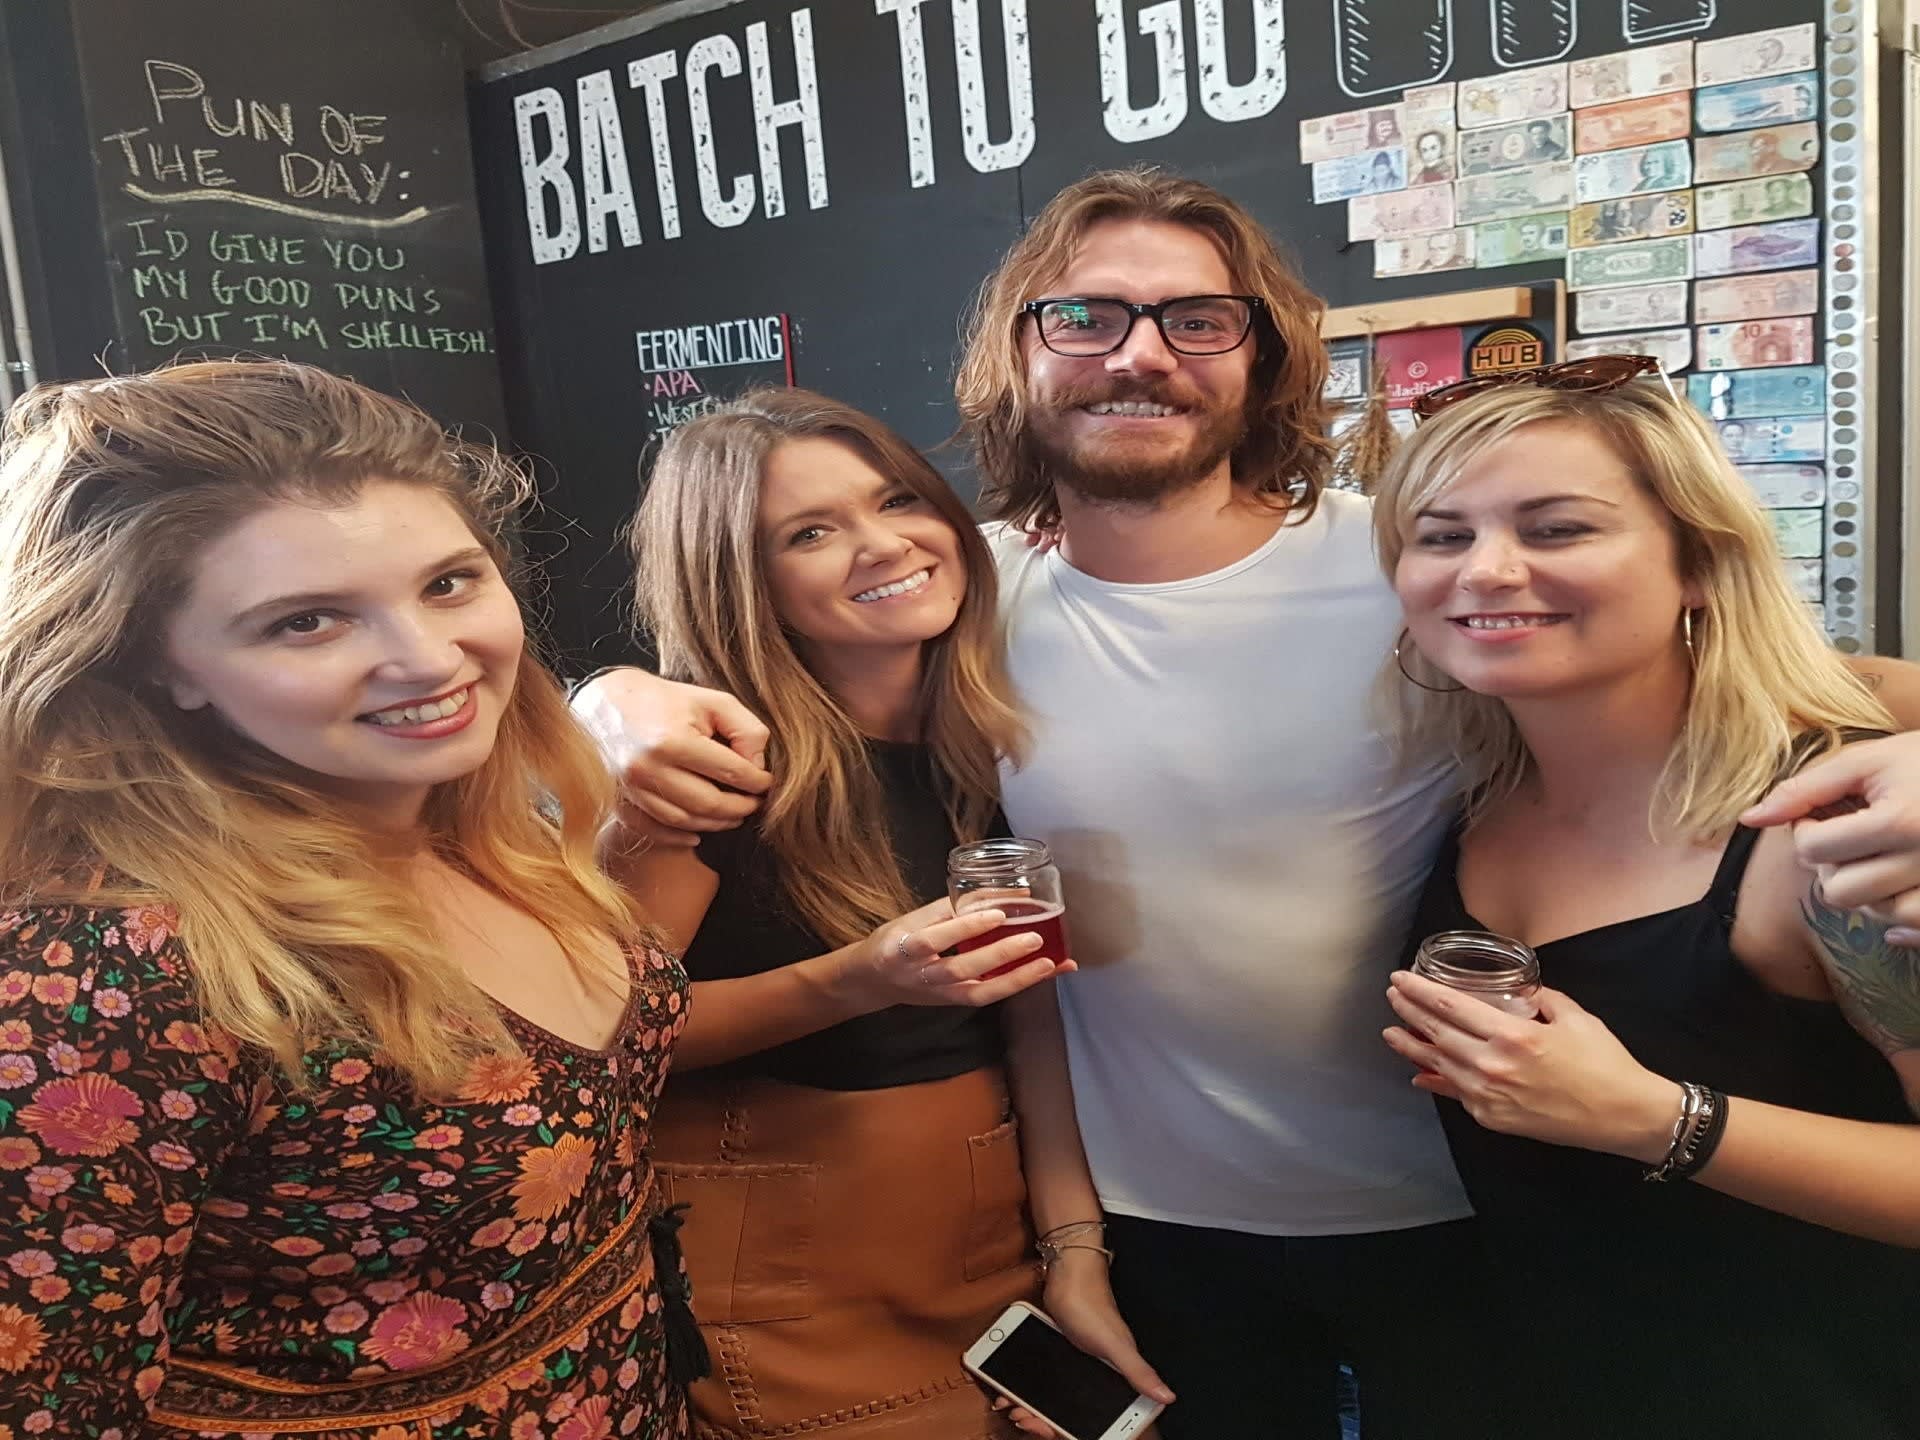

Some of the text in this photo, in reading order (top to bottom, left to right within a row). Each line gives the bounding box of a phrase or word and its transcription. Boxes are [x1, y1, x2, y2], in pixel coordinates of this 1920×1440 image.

[144, 59, 388, 156] PUN OF
[513, 0, 1287, 265] BATCH TO GO
[102, 127, 410, 204] THE DAY:
[127, 214, 405, 272] I'D GIVE YOU
[132, 265, 441, 314] MY GOOD PUNS
[139, 306, 497, 354] BUT I'M SHELLFISH.
[636, 316, 784, 371] FERMENTING
[1476, 344, 1537, 368] HUB
[653, 370, 701, 398] APA
